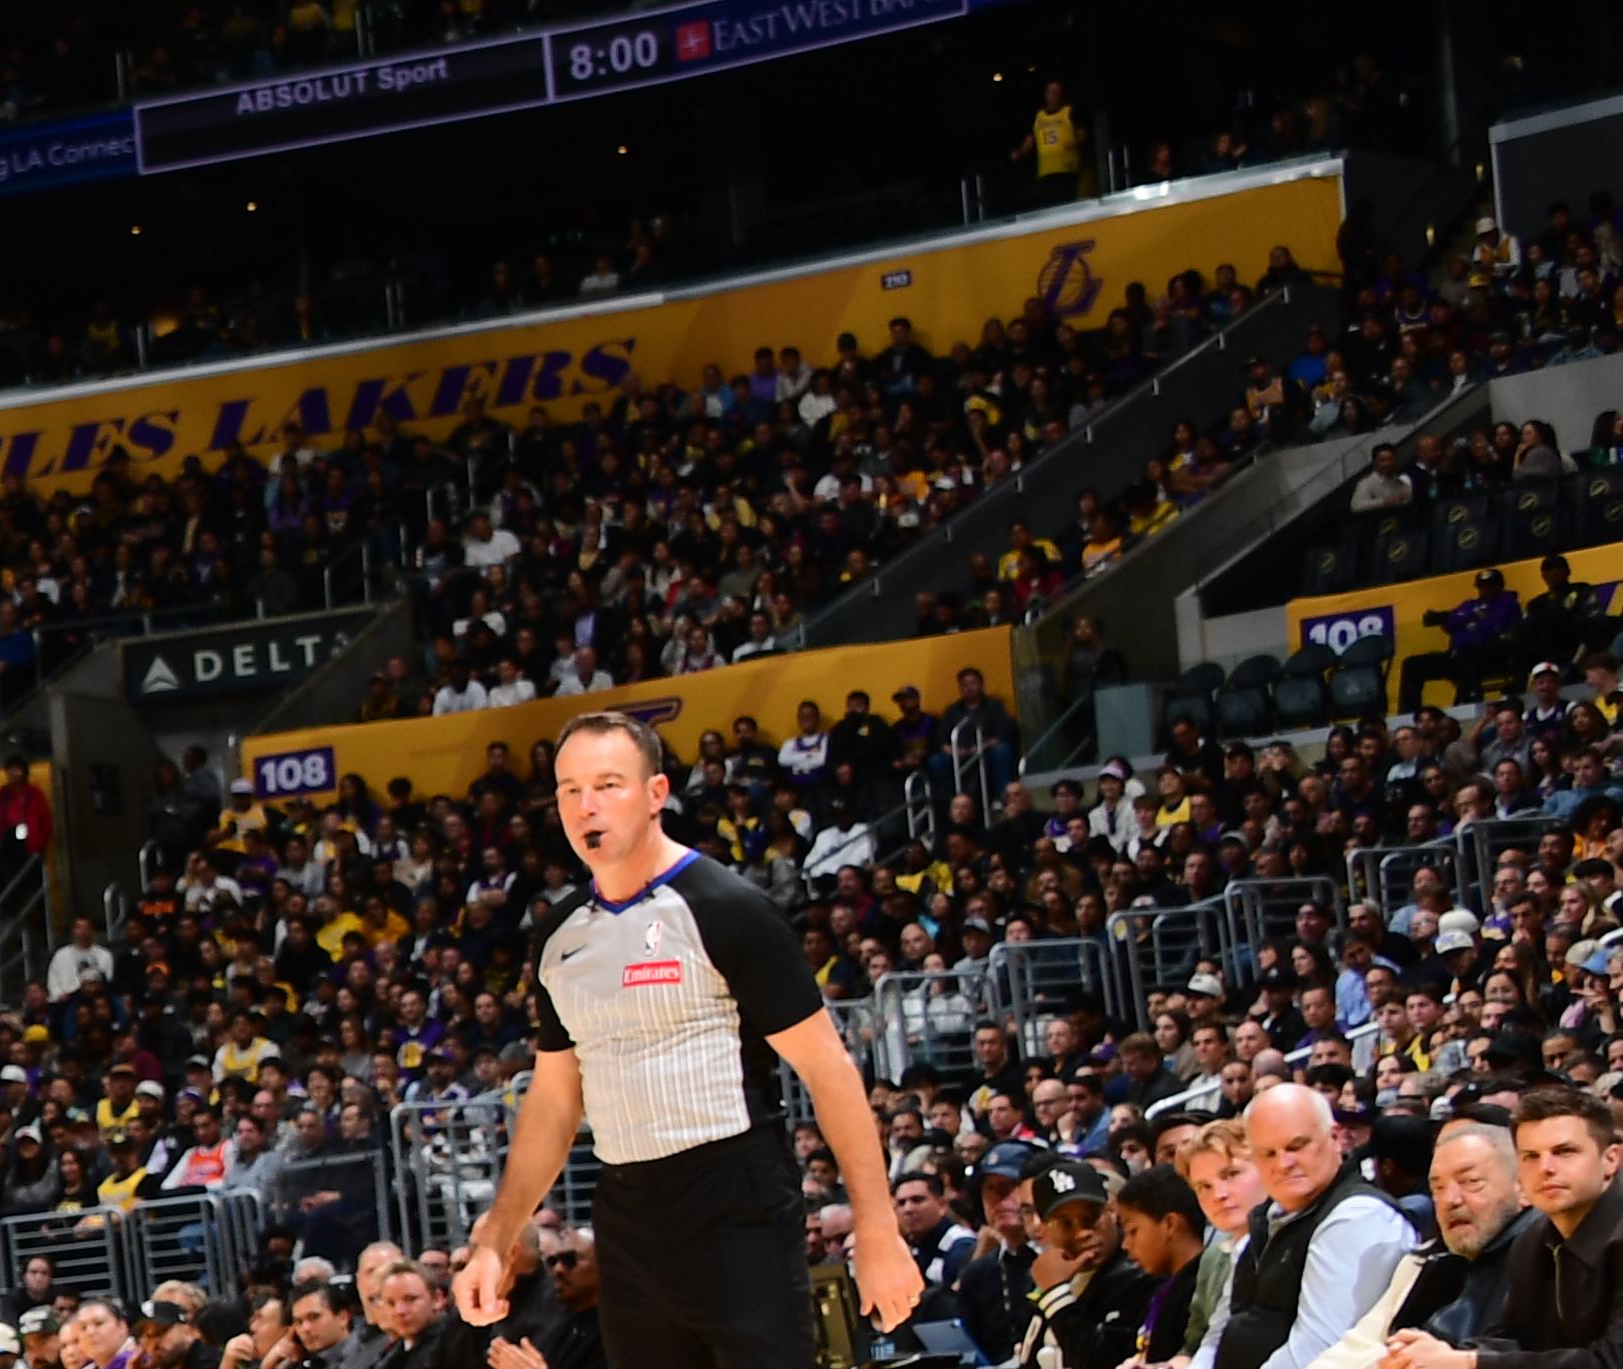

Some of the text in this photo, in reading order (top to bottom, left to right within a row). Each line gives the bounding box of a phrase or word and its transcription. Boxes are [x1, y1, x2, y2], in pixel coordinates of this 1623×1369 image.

[569, 33, 658, 81] 8:00
[235, 58, 449, 116] ABSOLUT Sport
[12, 147, 44, 173] LA
[48, 137, 135, 167] Connec
[212, 338, 637, 448] LAKERS
[259, 750, 330, 794] 108
[624, 964, 681, 985] Emirates
